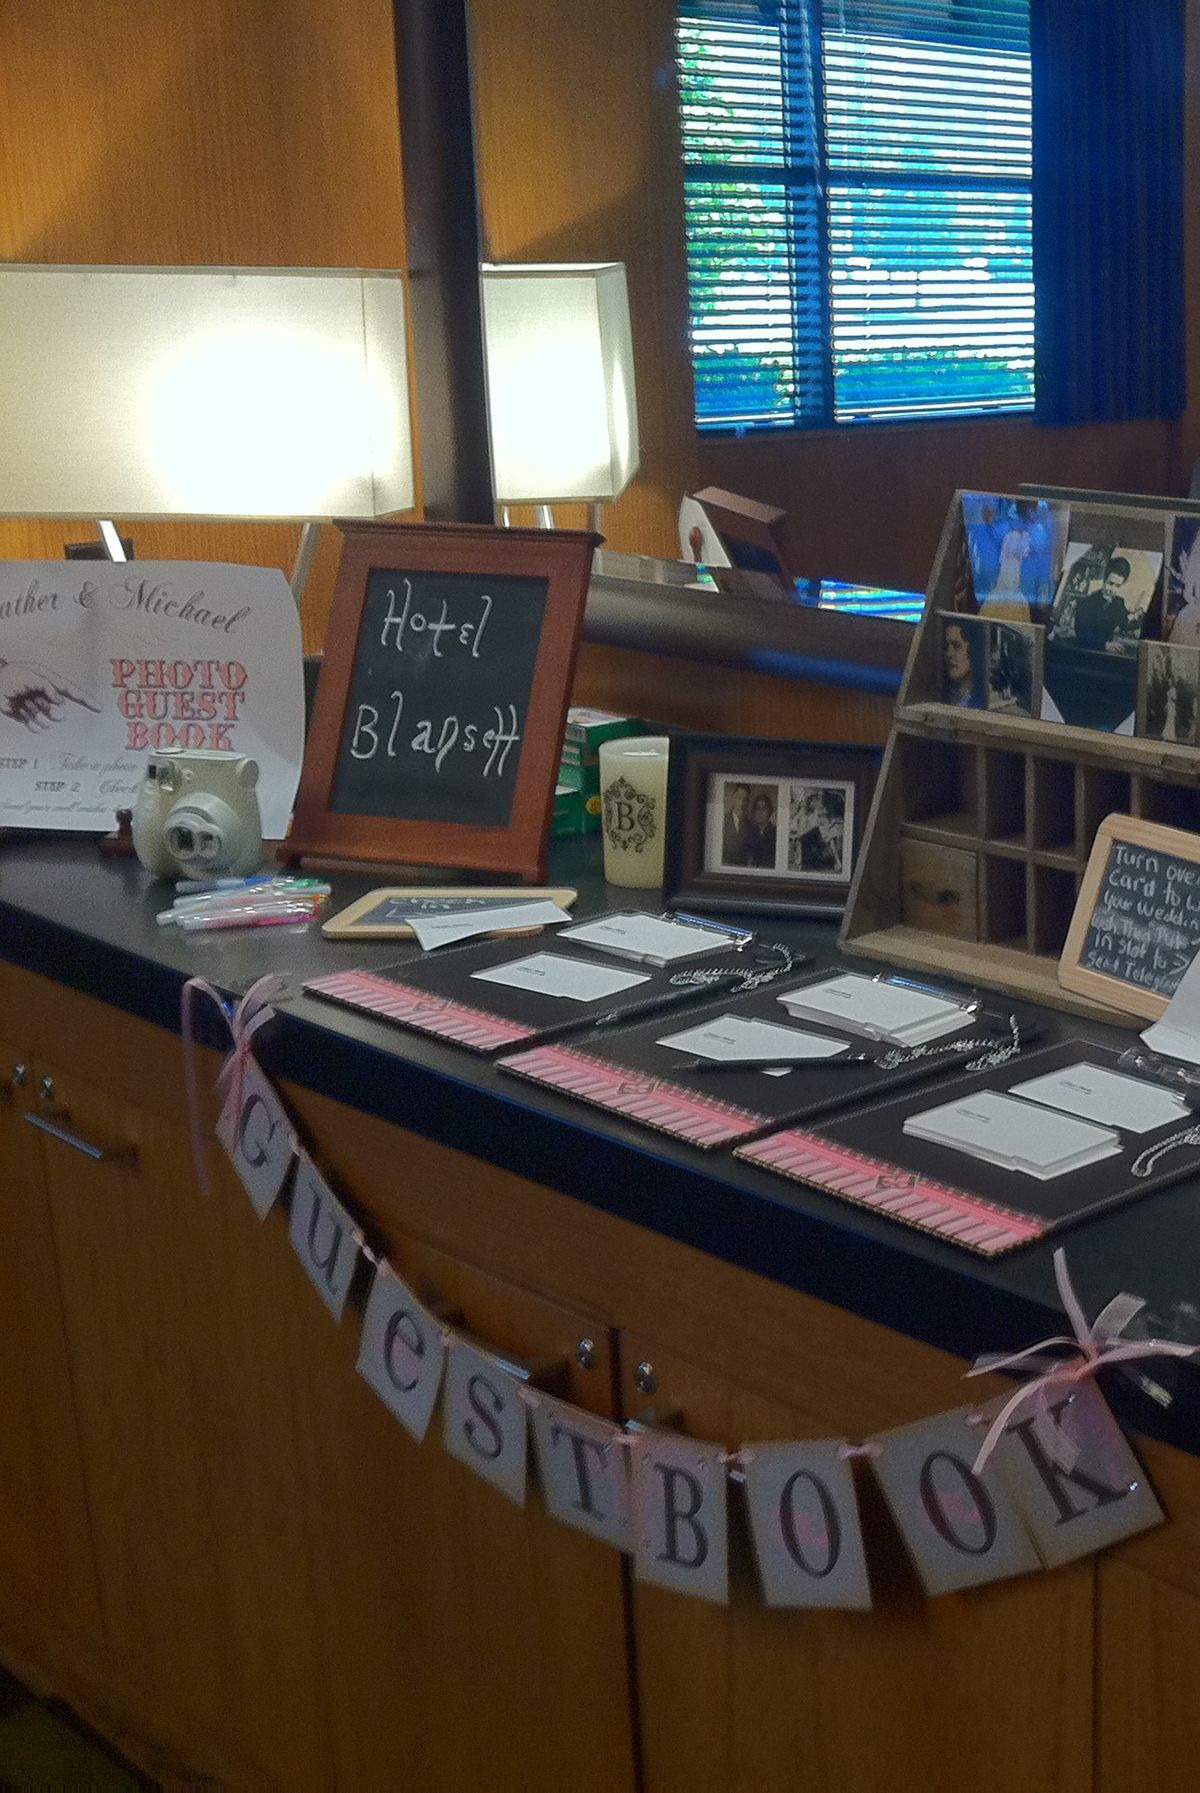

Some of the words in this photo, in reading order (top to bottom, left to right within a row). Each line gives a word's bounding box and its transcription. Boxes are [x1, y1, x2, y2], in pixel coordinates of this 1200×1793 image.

[73, 580, 98, 609] &
[109, 576, 250, 634] Michael
[380, 577, 492, 659] Hotel
[110, 658, 248, 689] PHOTO
[117, 690, 245, 721] GUEST
[125, 721, 236, 751] BOOK
[614, 801, 636, 832] B
[1115, 845, 1159, 874] Turn
[1163, 882, 1181, 906] to
